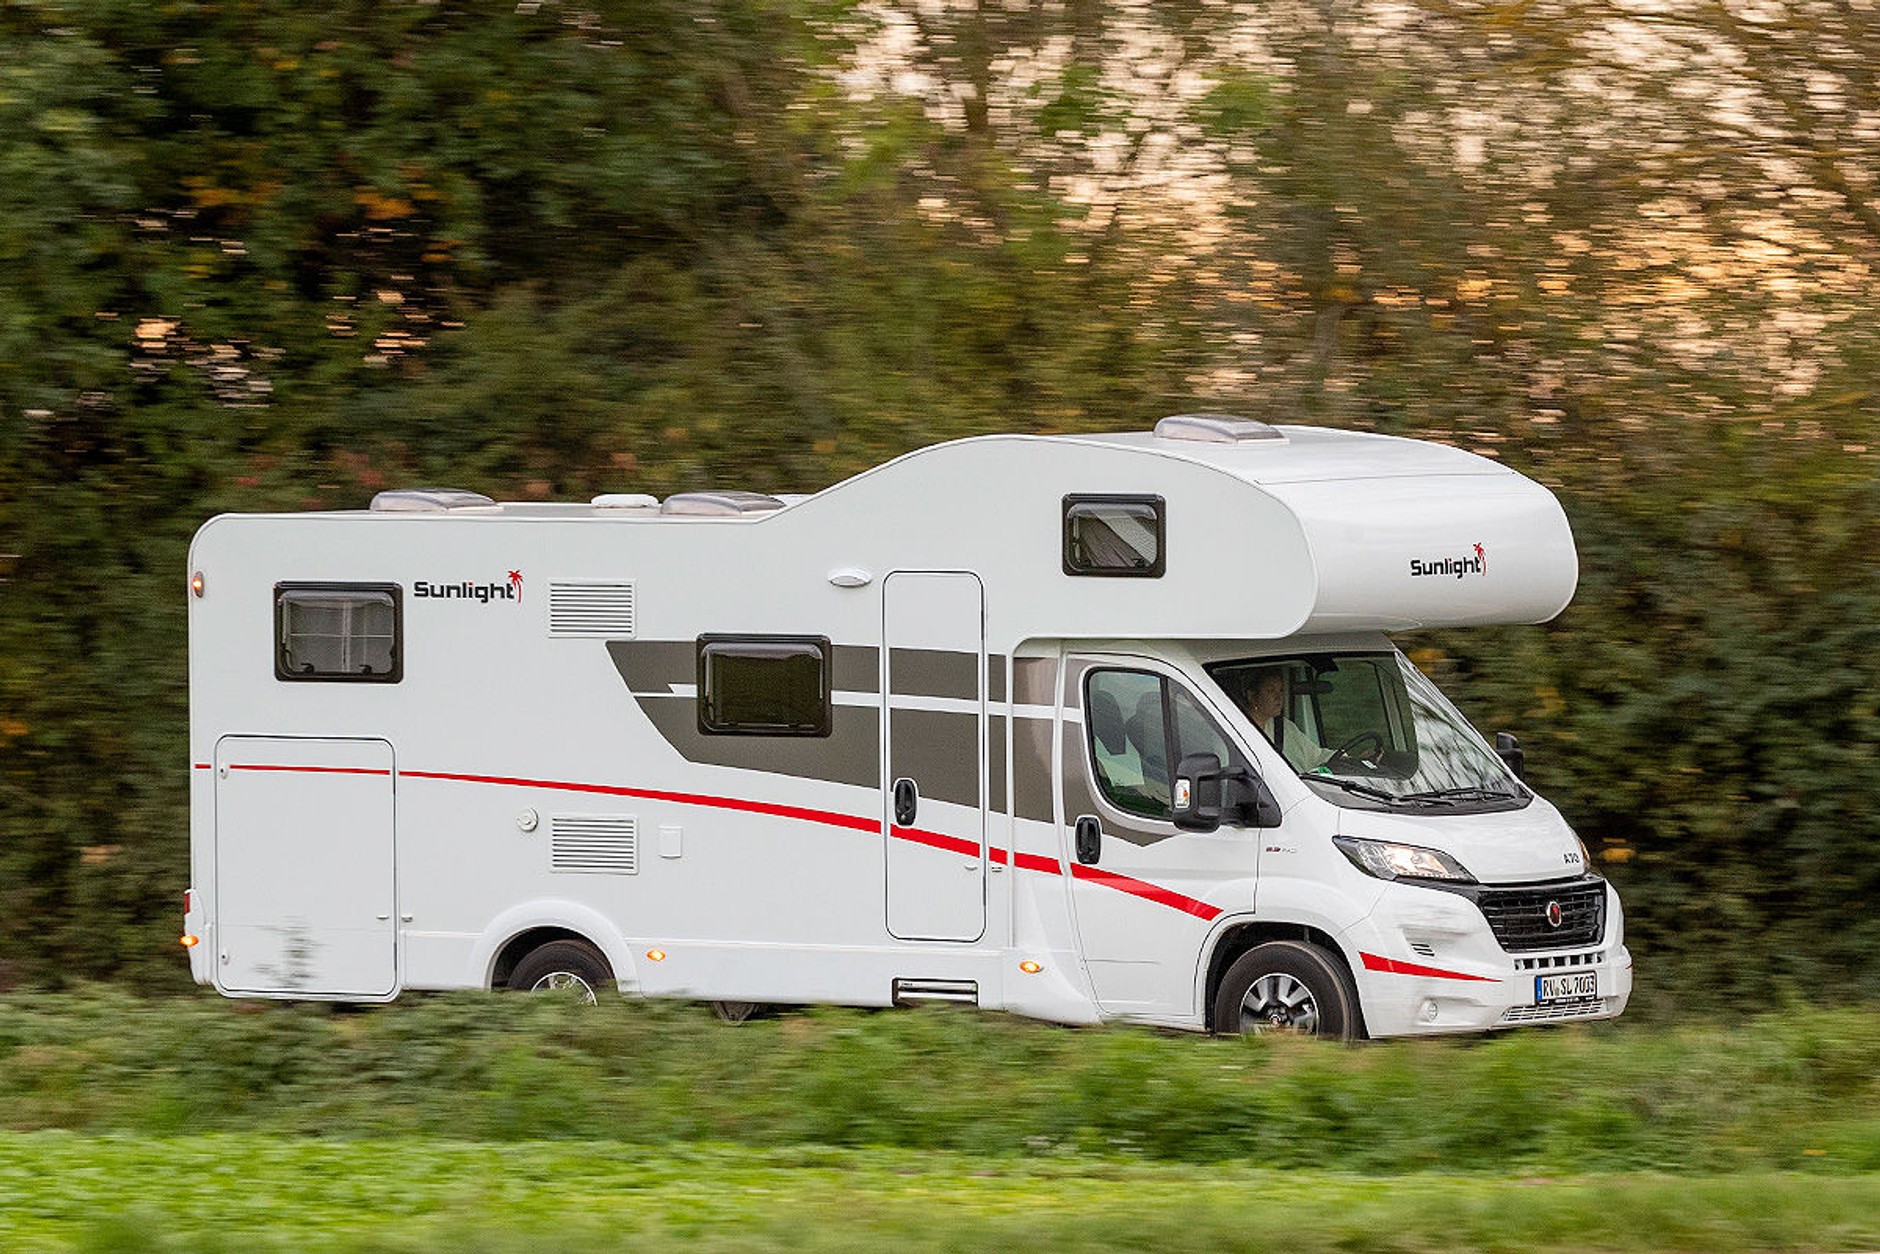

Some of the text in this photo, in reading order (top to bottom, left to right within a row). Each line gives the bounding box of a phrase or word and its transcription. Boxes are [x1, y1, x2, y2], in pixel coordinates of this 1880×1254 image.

[1410, 556, 1482, 579] Sunlight
[413, 581, 515, 603] Sunlight
[1560, 977, 1573, 995] SL
